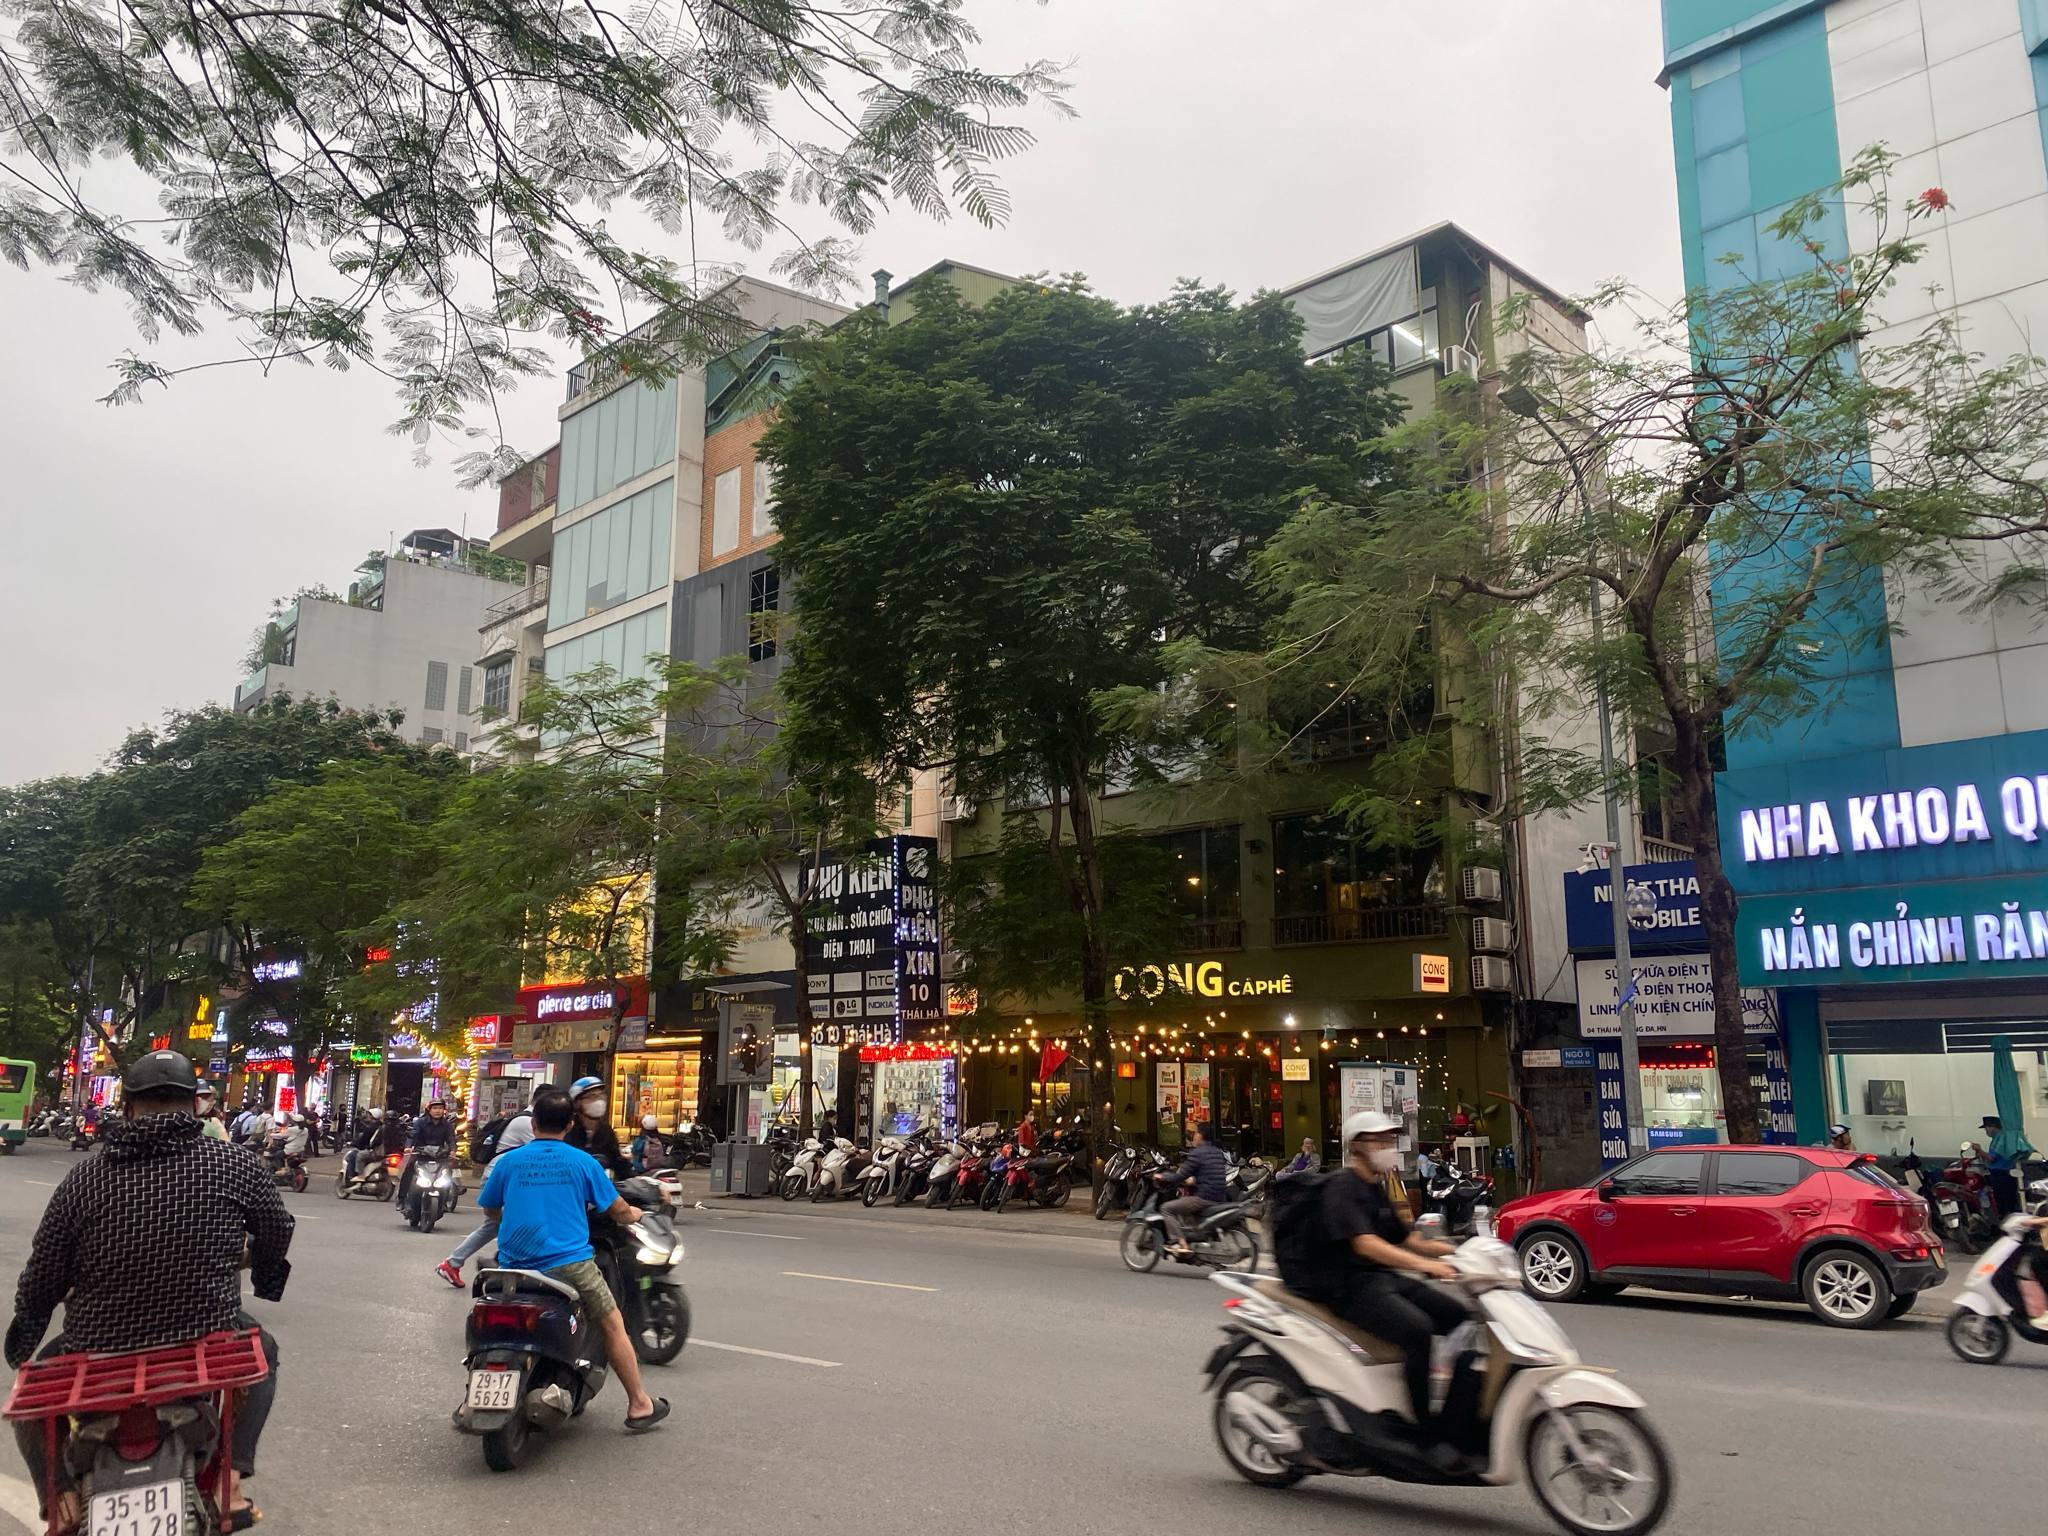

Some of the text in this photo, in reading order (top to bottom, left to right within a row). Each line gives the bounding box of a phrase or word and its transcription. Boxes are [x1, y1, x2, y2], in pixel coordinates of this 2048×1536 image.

[1741, 801, 1840, 862] NHA
[1848, 784, 1991, 851] KHOA
[850, 905, 868, 930] SỬA
[1761, 901, 2048, 971] NẮN CHỈNH RĂN
[850, 938, 875, 958] THOẠI
[905, 950, 935, 980] XỊN
[1668, 963, 1698, 980] ĐIỆN
[909, 983, 929, 1002] 10
[1644, 982, 1674, 998] ĐIỆN
[538, 990, 613, 1018] pierre cardin
[847, 1000, 857, 1009] LG
[868, 1001, 894, 1009] NOKIA
[1590, 1005, 1617, 1016] LINH
[1651, 1000, 1680, 1016] KIỆN
[1598, 1052, 1619, 1070] MUA
[1601, 1078, 1620, 1100] BÁN
[1603, 1104, 1622, 1129] SỬA
[1772, 1110, 1797, 1133] CHÍN
[1650, 1130, 1684, 1138] SAMSUNG
[1602, 1136, 1628, 1159] CHỮA
[474, 1391, 510, 1407] 5629
[105, 1486, 168, 1522] 35-B1
